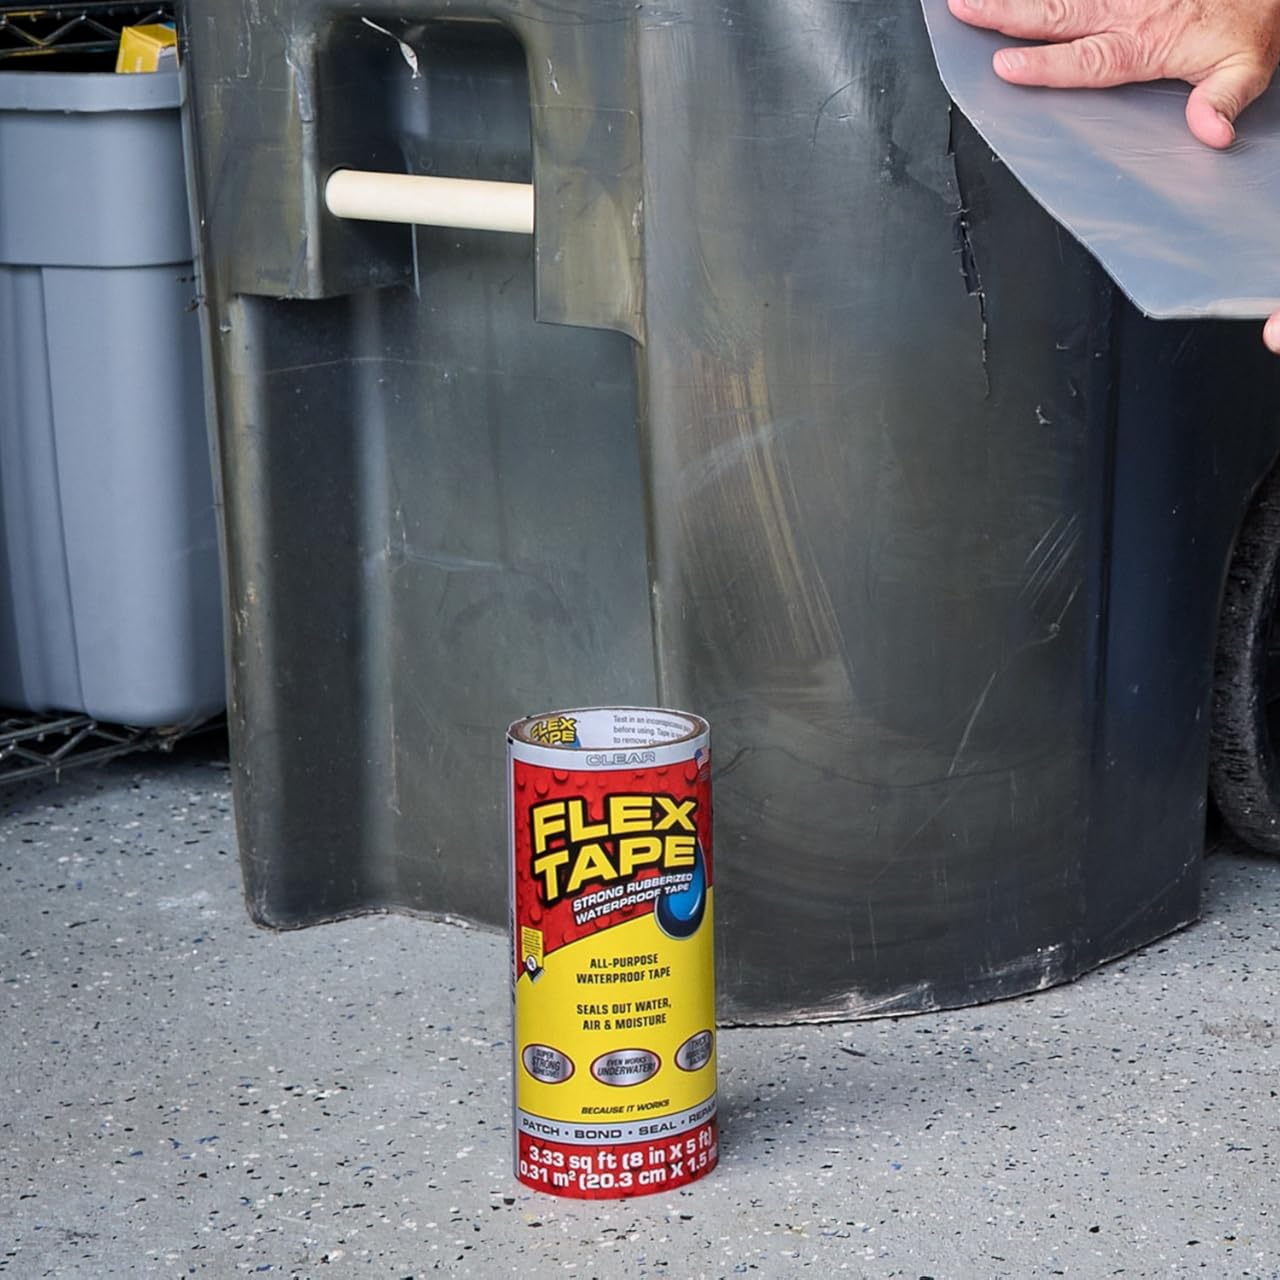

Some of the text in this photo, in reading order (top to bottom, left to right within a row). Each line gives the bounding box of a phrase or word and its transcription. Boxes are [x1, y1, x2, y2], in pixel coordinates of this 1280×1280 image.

[629, 715, 635, 723] in
[539, 730, 576, 744] APE
[613, 725, 636, 733] before
[585, 751, 656, 767] CLEAR
[530, 793, 698, 856] FLEX
[532, 834, 697, 902] TAPE
[573, 873, 693, 912] STRONG RUBBERIZED
[575, 883, 690, 925] WATERPROOF TAPE
[590, 953, 659, 969] ALL-PURPOSE
[576, 966, 671, 984] WATERPROOF TAPE
[576, 997, 672, 1015] SEALS OUT WATER,
[582, 1013, 667, 1031] AIR & MOISTURE
[581, 1099, 670, 1115] BECAUSE IT WORKS
[522, 1101, 716, 1139] PATCH BOND SEAL REPAI
[529, 1145, 565, 1167] 3.33
[569, 1155, 592, 1174] sq
[597, 1151, 617, 1170] ft
[622, 1151, 644, 1170] (8
[648, 1146, 666, 1165] in
[686, 1138, 697, 1155] 5
[520, 1159, 549, 1183] 0.31
[579, 1171, 633, 1190] (20.3
[638, 1167, 667, 1185] cm
[687, 1151, 708, 1173] 1.5
